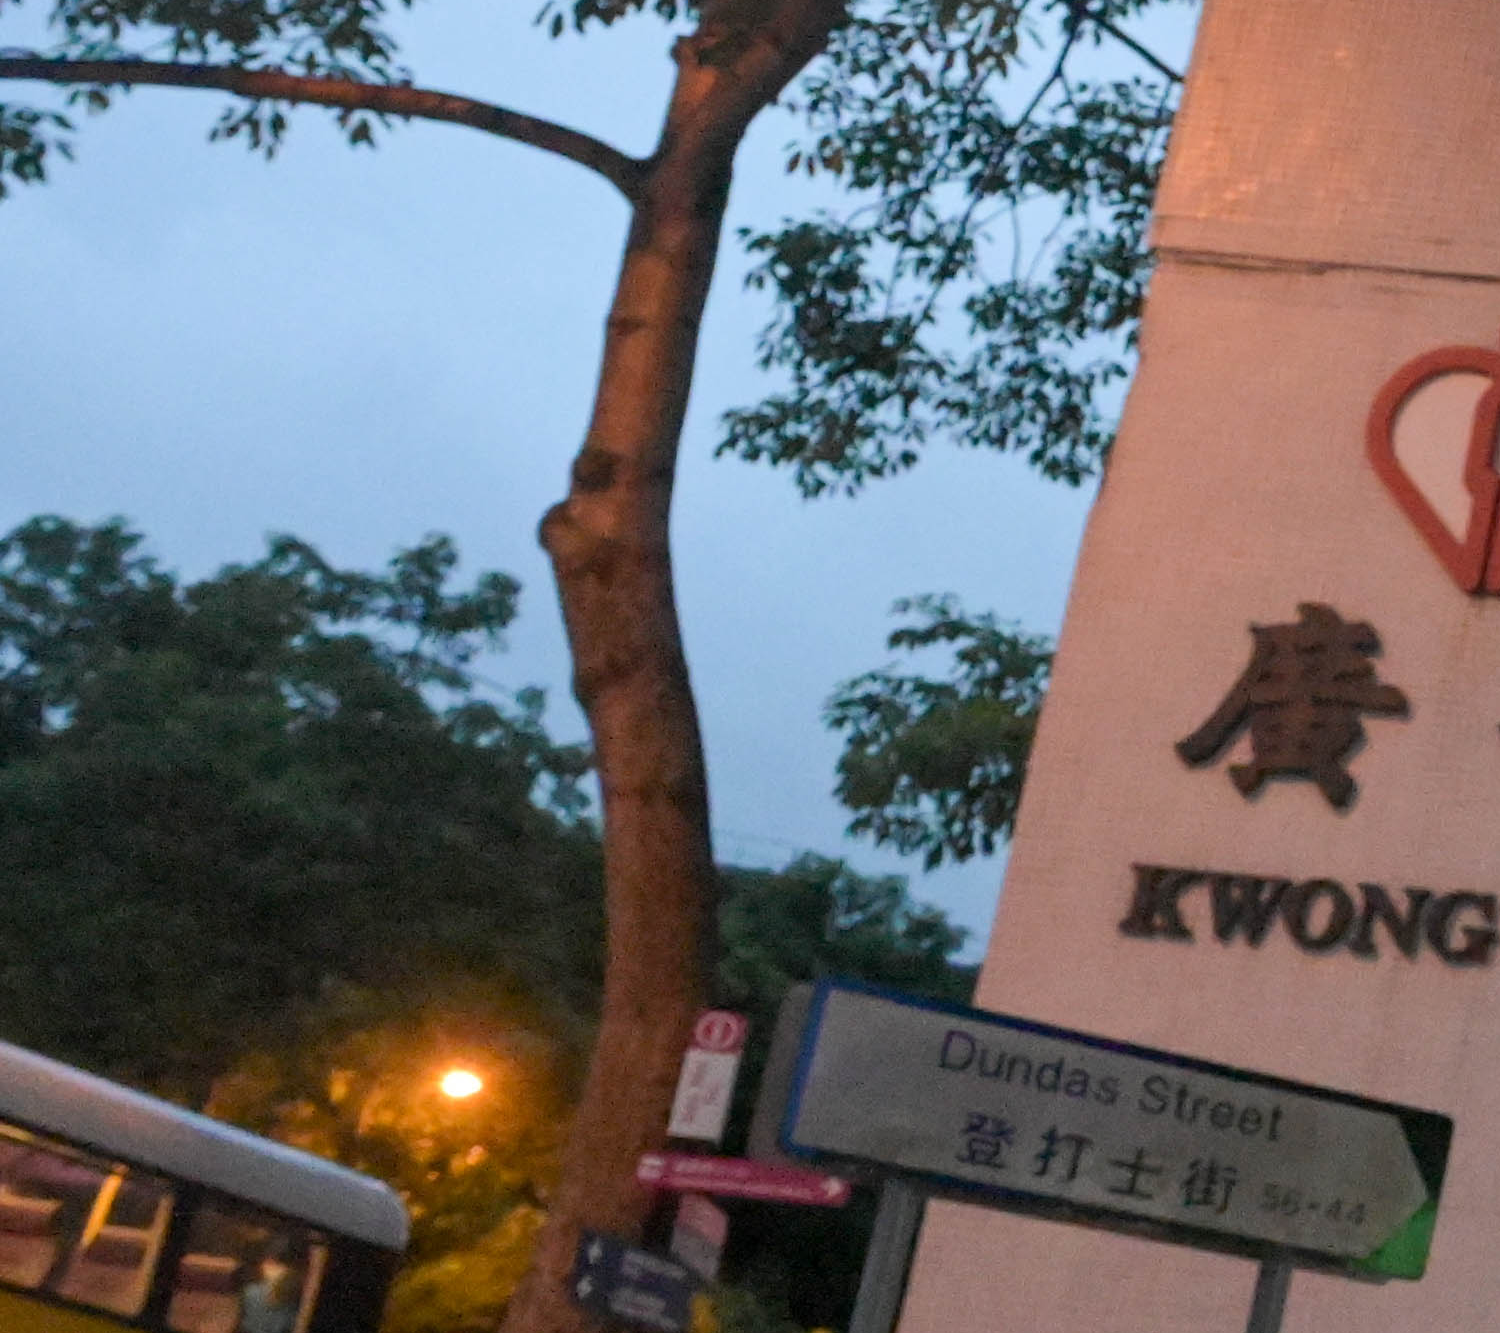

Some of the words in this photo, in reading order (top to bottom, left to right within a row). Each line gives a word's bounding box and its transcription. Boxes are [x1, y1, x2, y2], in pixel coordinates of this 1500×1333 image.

[1120, 861, 1500, 967] KWONG
[938, 1028, 1119, 1105] Dundas
[1138, 1075, 1285, 1142] Street
[955, 1112, 1239, 1215] 登打士街
